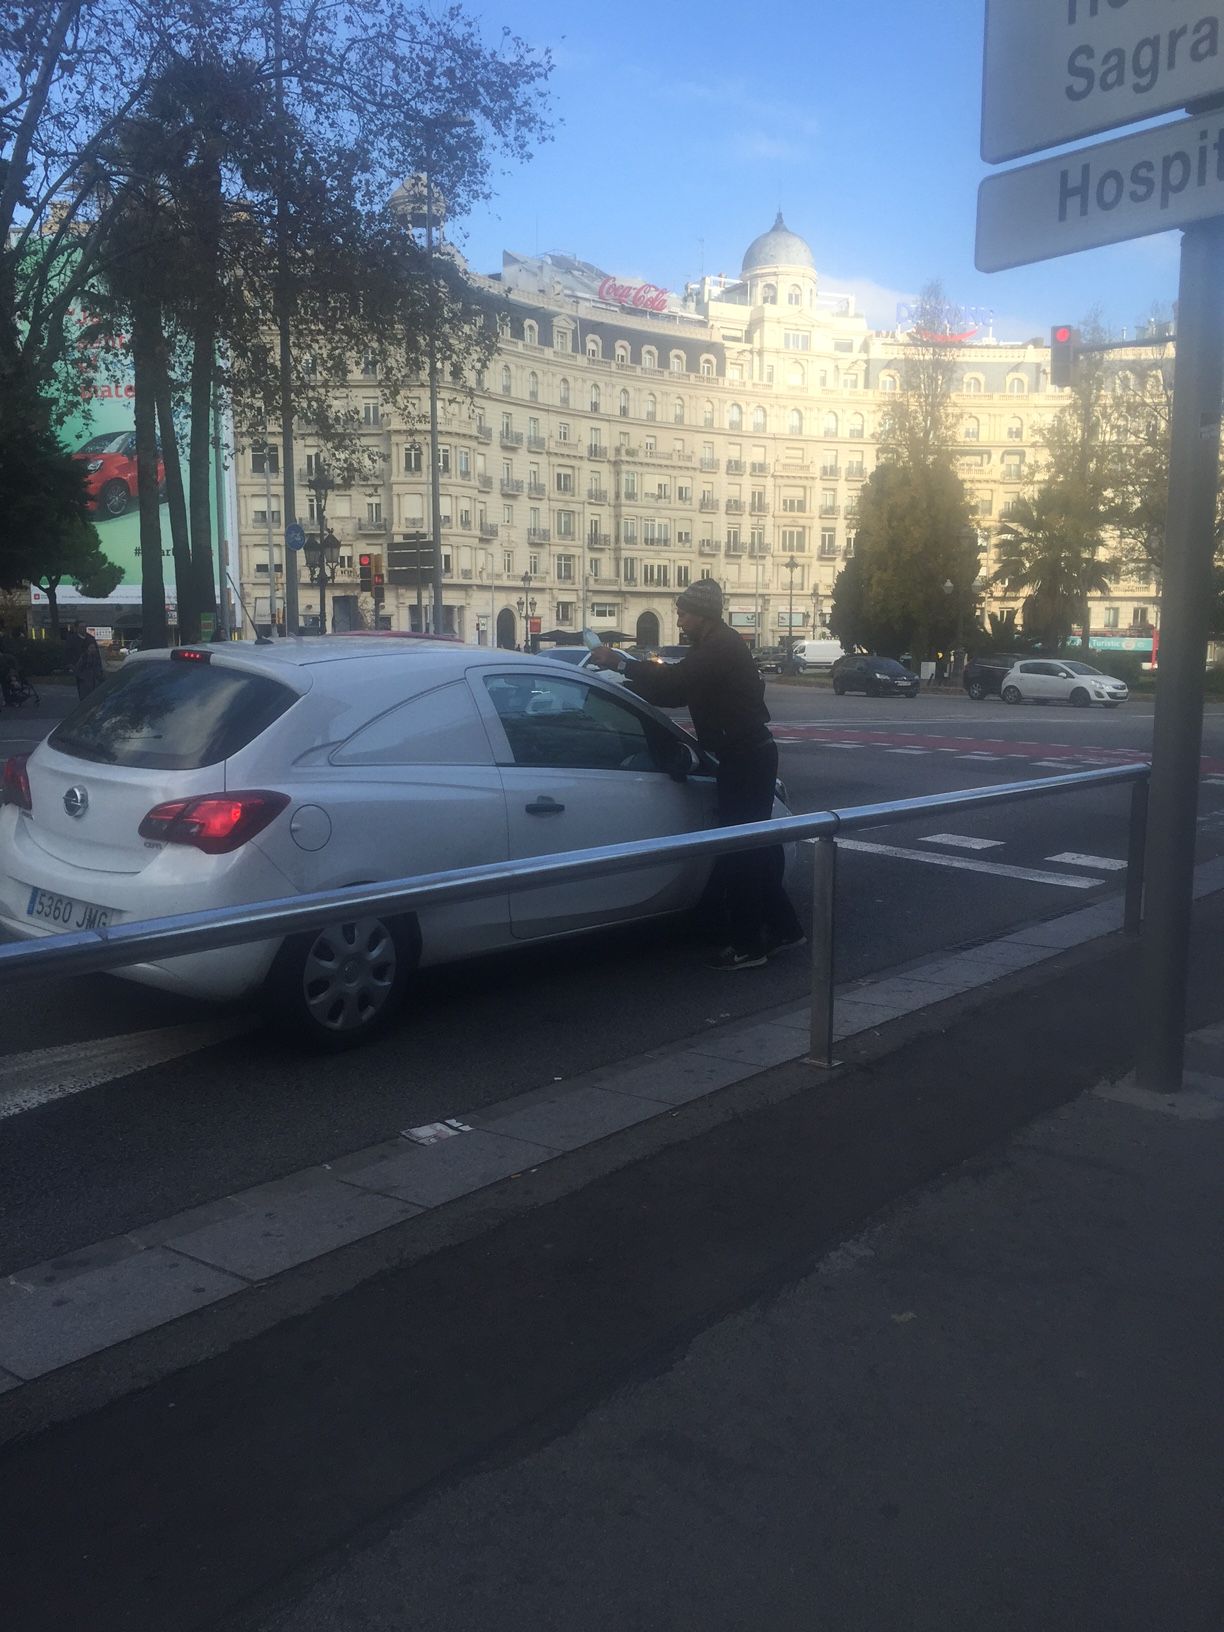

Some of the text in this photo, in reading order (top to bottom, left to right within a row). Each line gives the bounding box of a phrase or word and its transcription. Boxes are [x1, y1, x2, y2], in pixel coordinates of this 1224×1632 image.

[1065, 15, 1220, 102] Sagra
[36, 892, 109, 930] 5360 JMG
